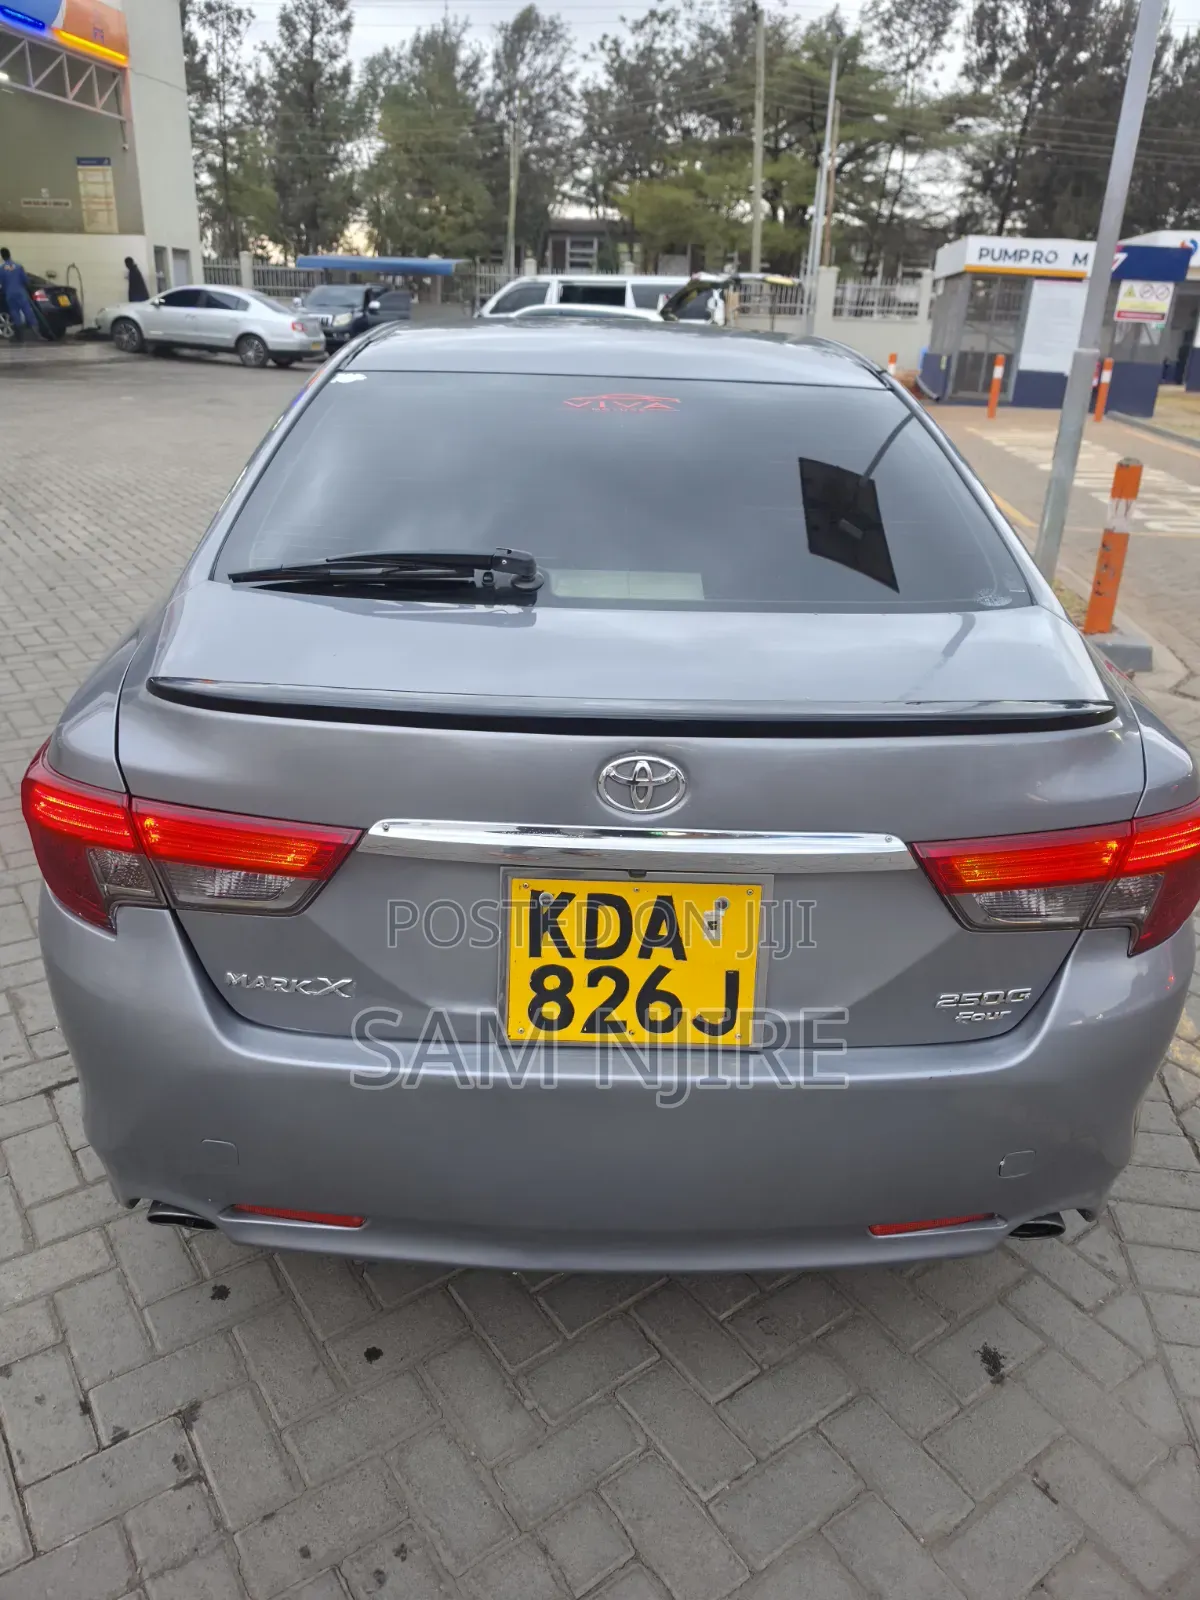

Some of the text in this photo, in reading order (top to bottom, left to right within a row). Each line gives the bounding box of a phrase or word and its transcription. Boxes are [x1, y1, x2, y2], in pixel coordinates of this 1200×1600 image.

[978, 246, 1058, 264] PUMPRO
[528, 889, 688, 961] KDA
[527, 964, 740, 1036] 826J
[935, 987, 1032, 1008] 250G
